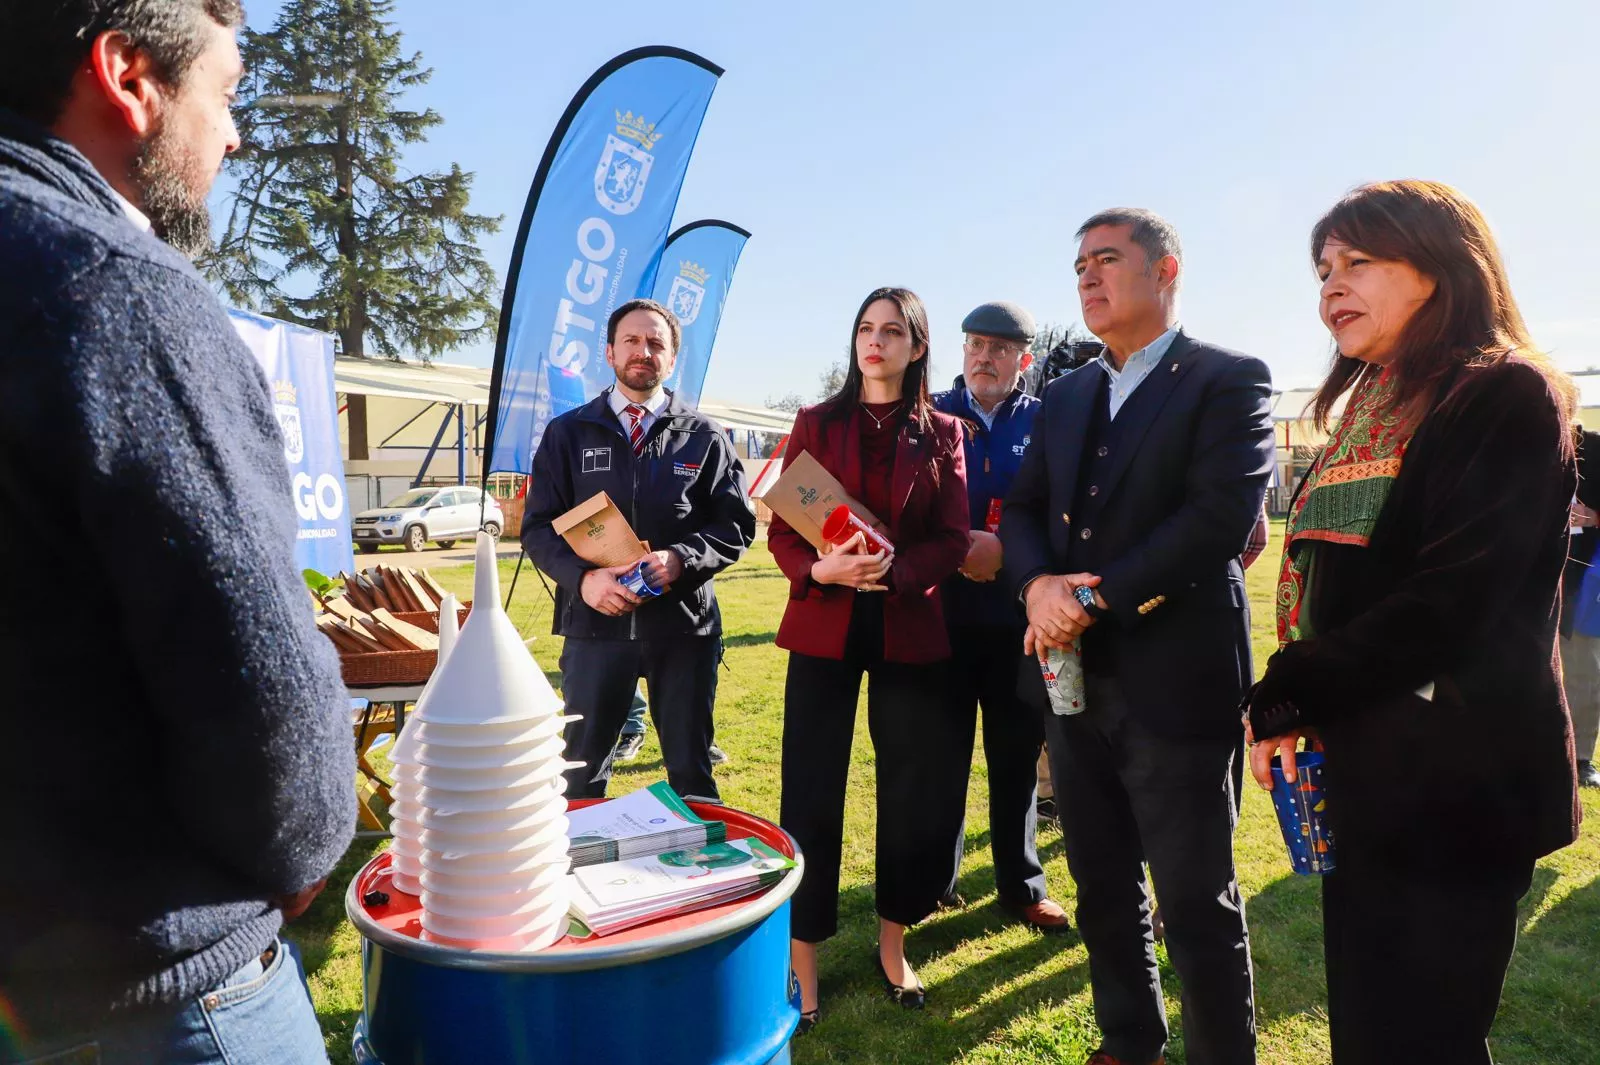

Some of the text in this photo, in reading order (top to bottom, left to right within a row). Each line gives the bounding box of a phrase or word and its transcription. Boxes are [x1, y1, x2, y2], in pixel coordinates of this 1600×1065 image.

[549, 217, 615, 375] STGO
[1012, 444, 1026, 453] ST
[293, 471, 344, 521] GO
[801, 488, 816, 504] STGO
[587, 524, 605, 538] STGO
